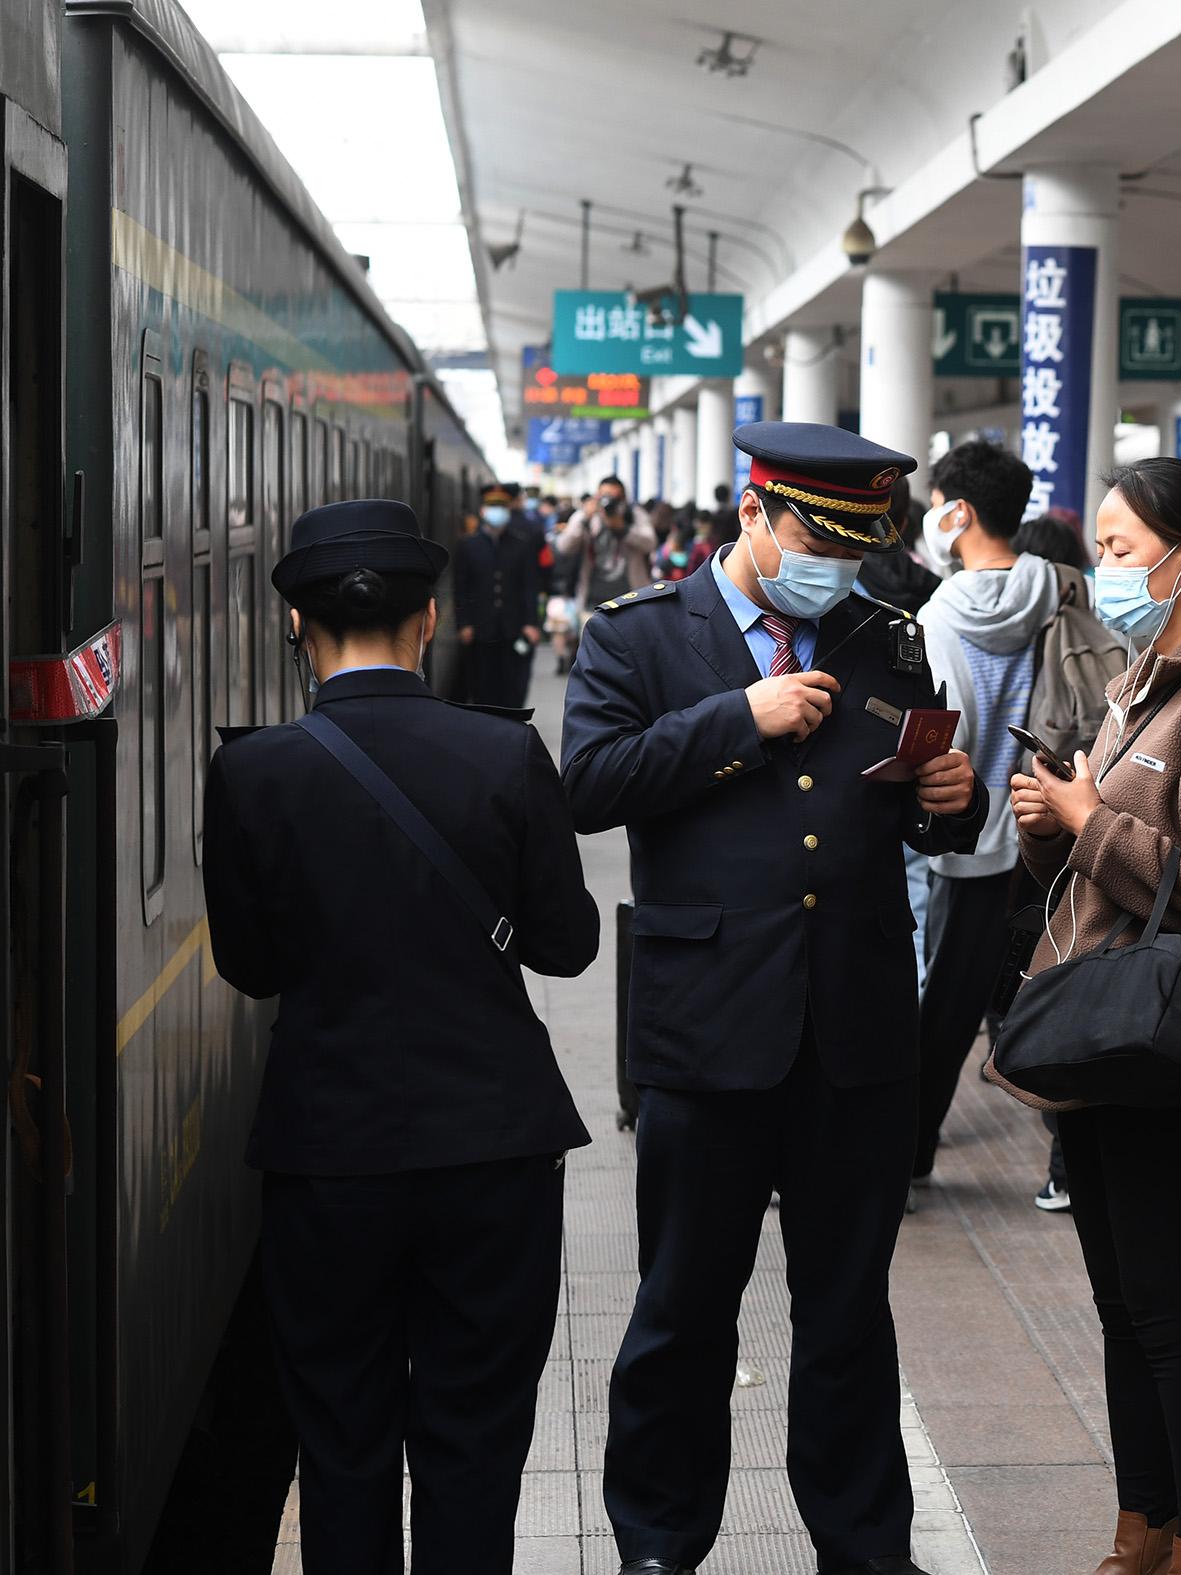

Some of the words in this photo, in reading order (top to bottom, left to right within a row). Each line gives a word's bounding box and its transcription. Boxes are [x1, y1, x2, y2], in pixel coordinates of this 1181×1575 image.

[575, 303, 674, 341] 出站口
[1021, 257, 1067, 524] 垃圾投放点
